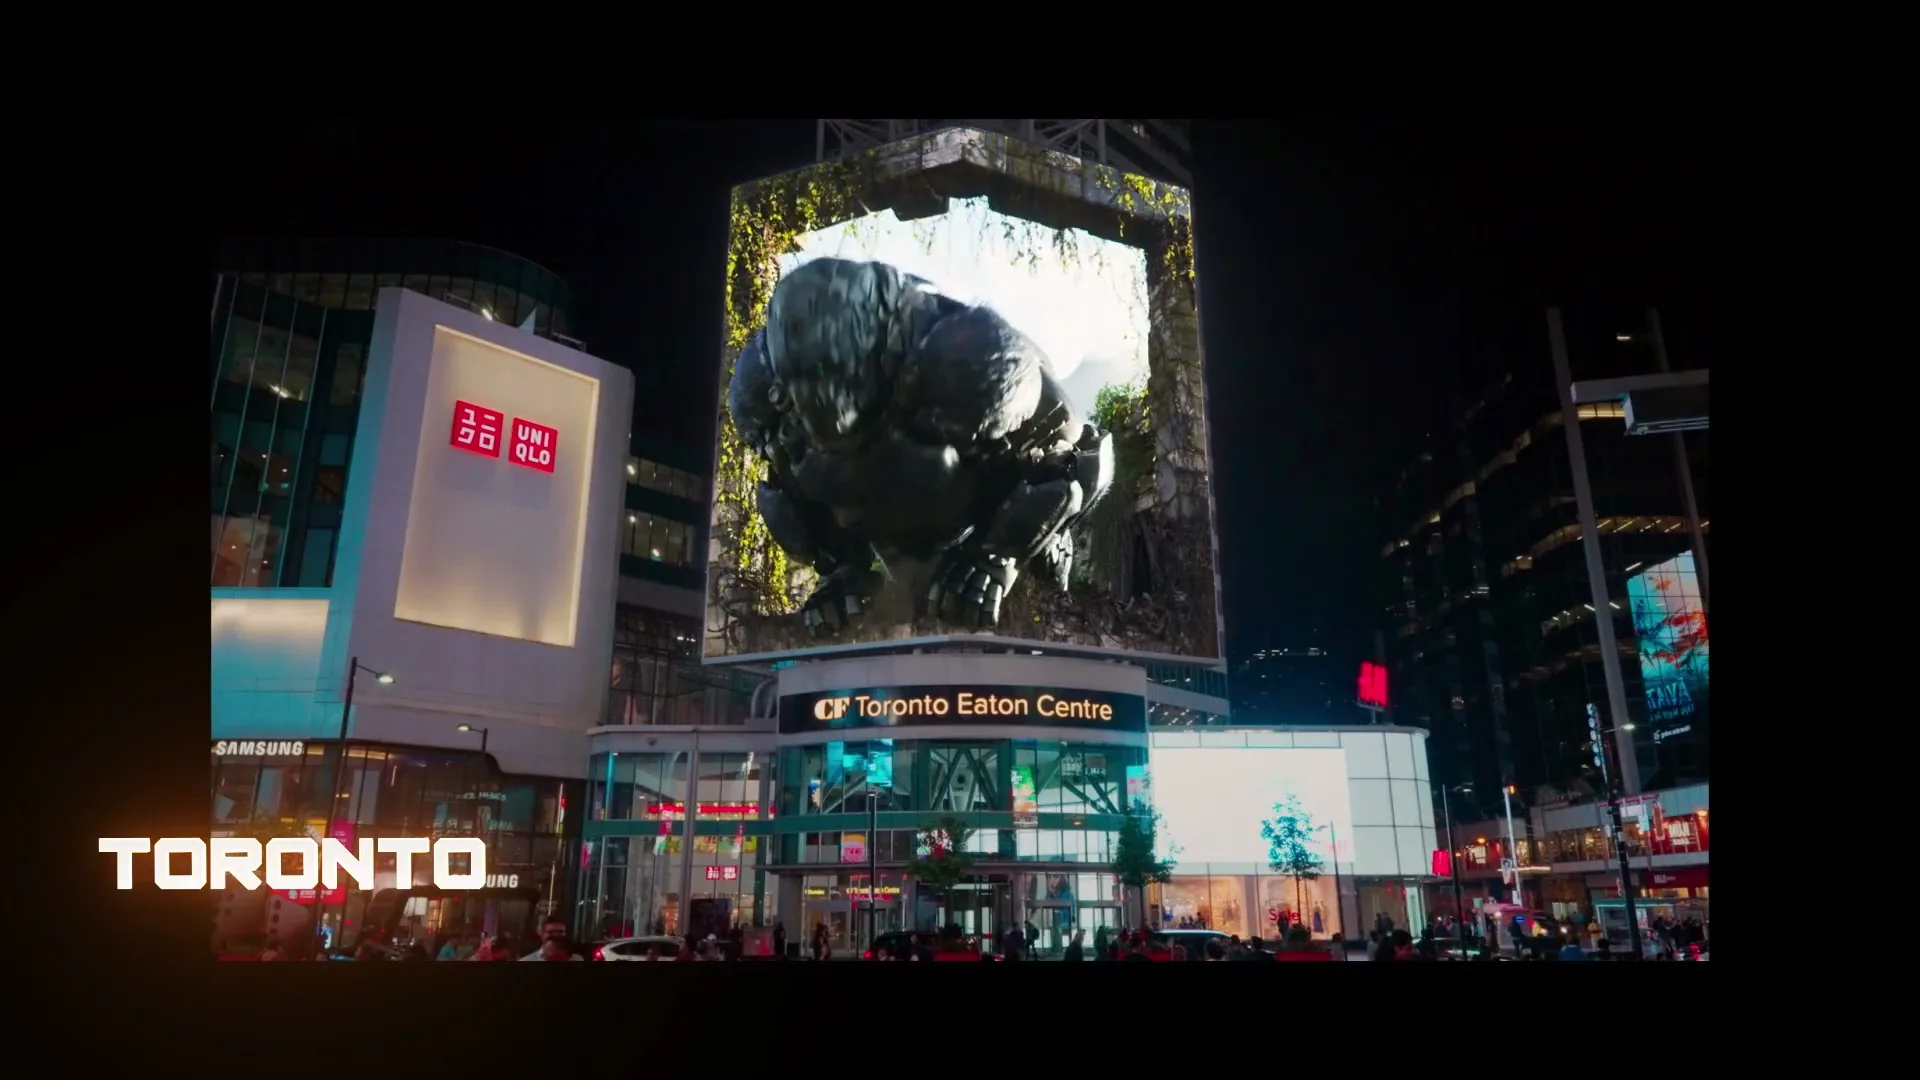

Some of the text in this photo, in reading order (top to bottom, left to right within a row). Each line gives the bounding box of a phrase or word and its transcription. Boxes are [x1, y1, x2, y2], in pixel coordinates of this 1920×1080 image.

[518, 424, 550, 448] UNI
[515, 443, 551, 465] QLO
[814, 693, 1113, 721] CF Toronto Eaton Centre
[216, 740, 304, 756] SAMSUNG
